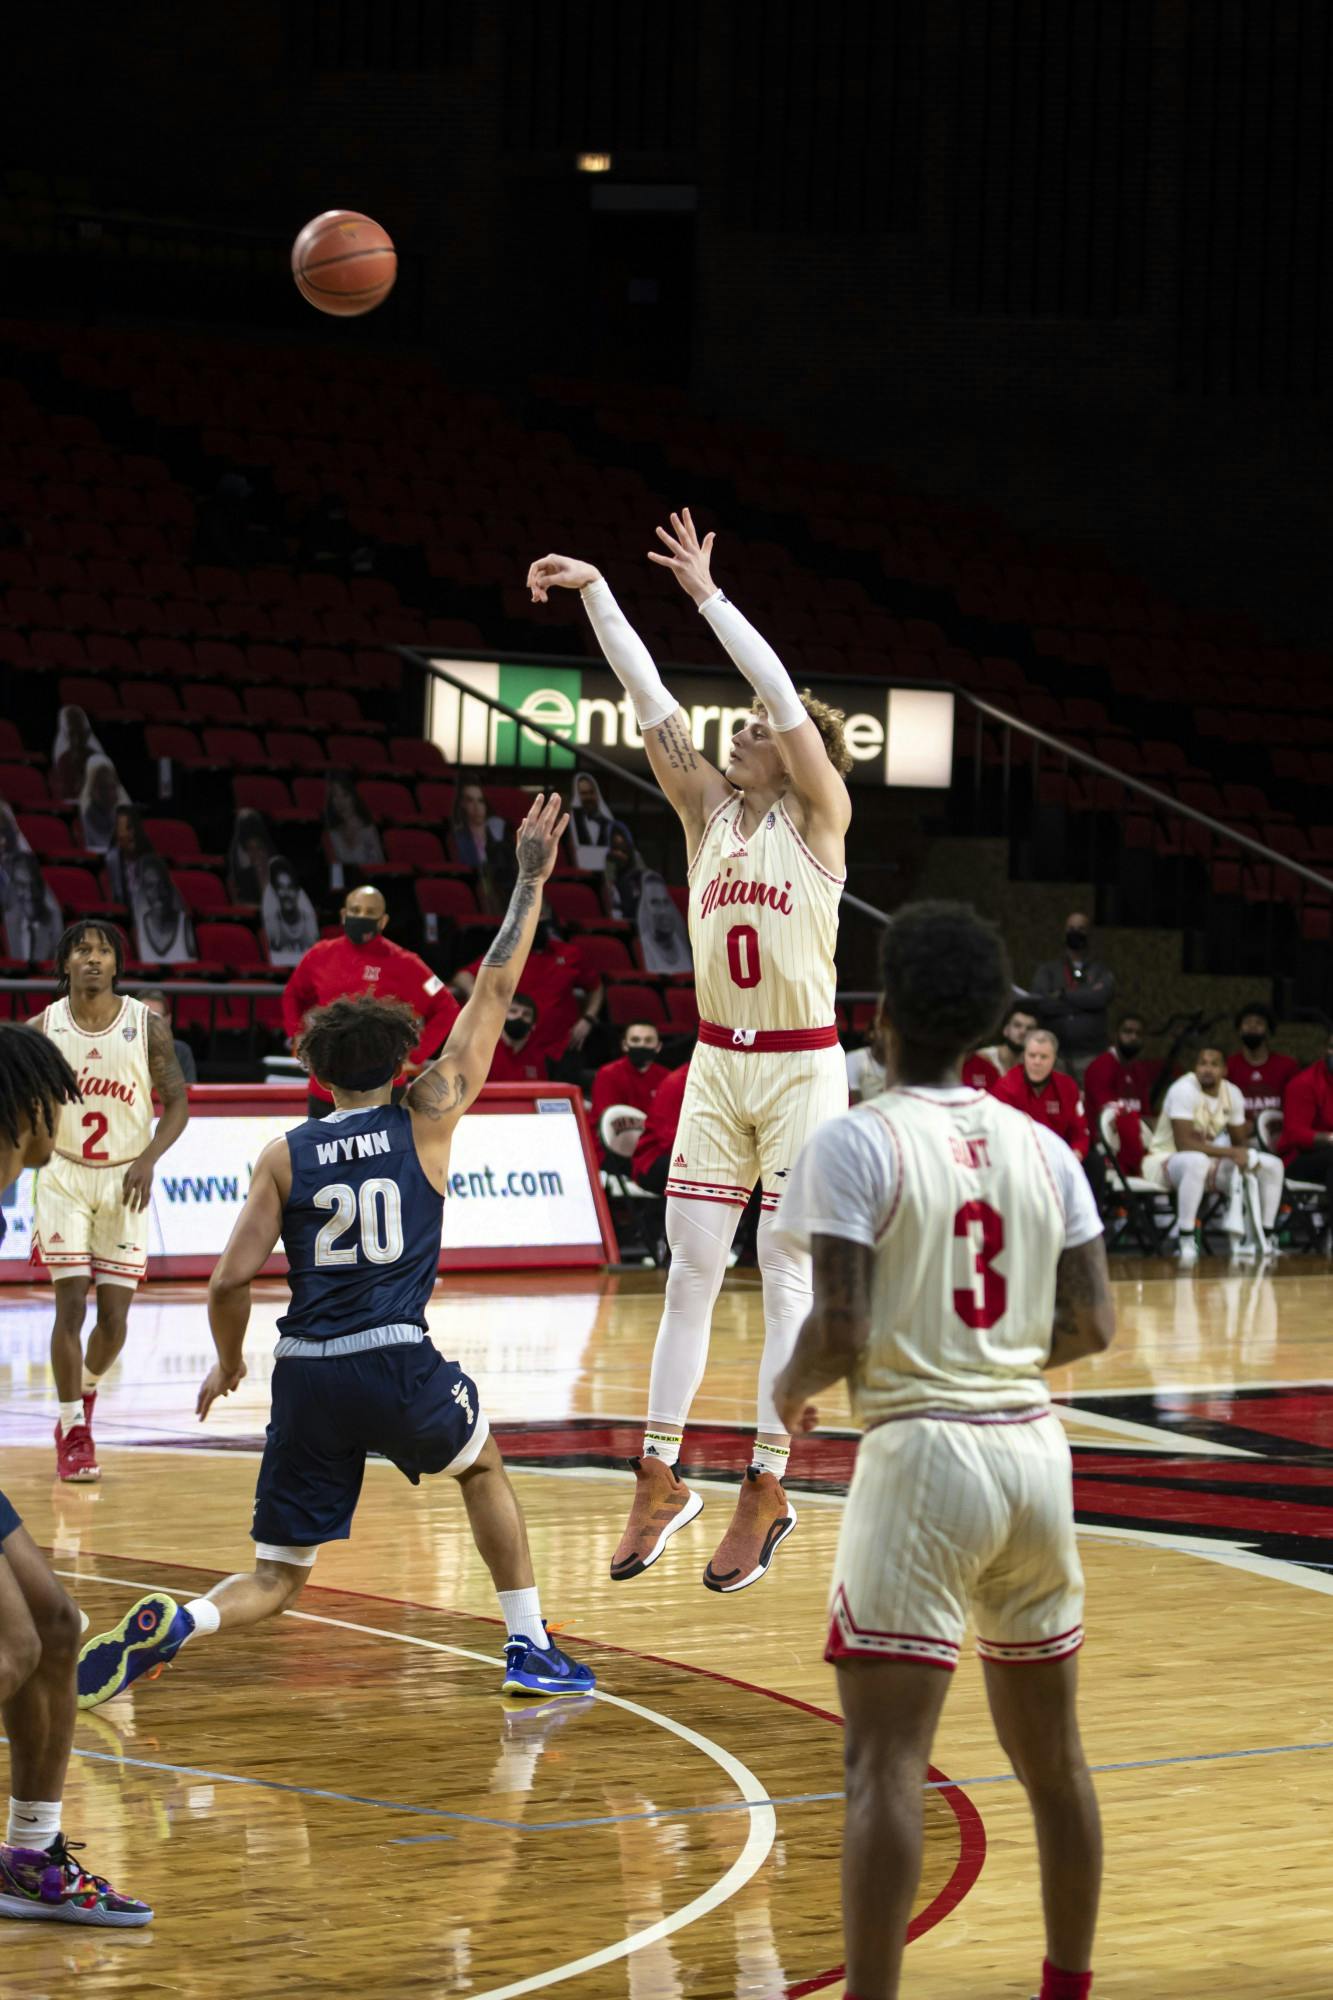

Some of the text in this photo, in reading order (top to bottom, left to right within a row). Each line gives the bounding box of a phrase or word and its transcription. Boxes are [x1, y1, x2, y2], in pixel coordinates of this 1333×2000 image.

[701, 867, 793, 919] Miami
[727, 925, 762, 989] 0
[75, 1066, 135, 1106] iami
[82, 1112, 109, 1160] 2
[316, 1130, 391, 1165] WYNN
[447, 1163, 564, 1198] ent.com
[313, 1178, 404, 1266] 20
[953, 1200, 1007, 1329] 3
